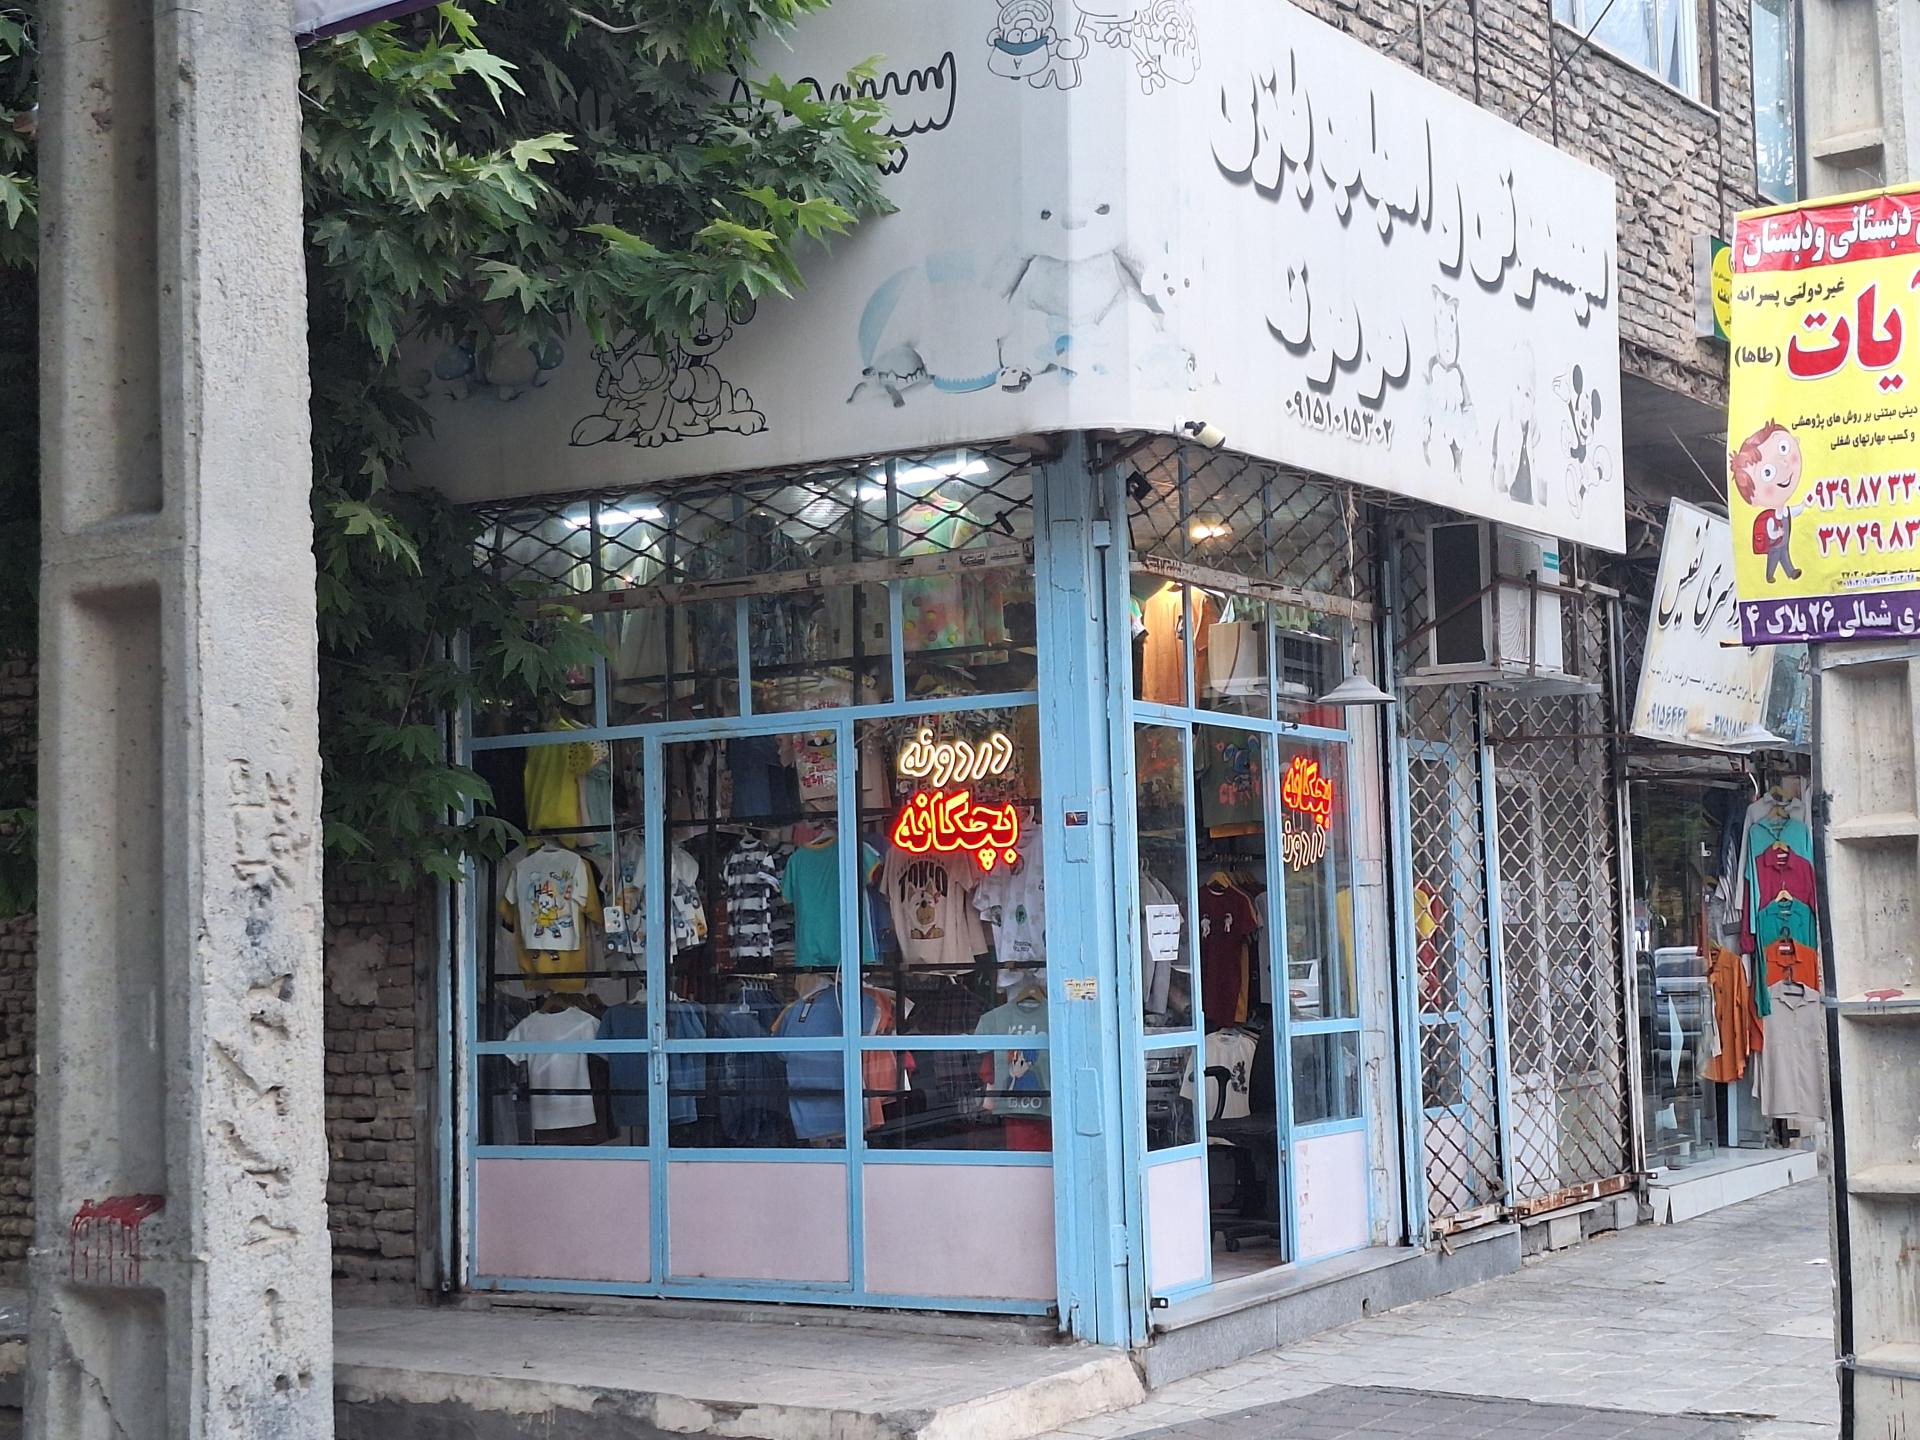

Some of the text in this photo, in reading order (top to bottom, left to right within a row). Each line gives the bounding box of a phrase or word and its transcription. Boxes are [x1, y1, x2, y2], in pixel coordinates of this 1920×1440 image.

[1209, 46, 1315, 214] بازی
[1318, 86, 1433, 247] اسباب
[1742, 216, 1813, 267] دبستان
[1829, 204, 1912, 259] دبستانی
[1736, 284, 1780, 307] پسرانه
[1264, 257, 1412, 412] دردونه
[1788, 270, 1920, 390] یات
[1734, 345, 1781, 368] (طاها)
[1285, 389, 1394, 447] ۰۹۱۵۱۰۱۵۳۰۲
[1791, 413, 1825, 430] پژوهشی
[1826, 412, 1841, 427] های
[1842, 409, 1862, 425] روش
[1863, 412, 1872, 423] بر
[1873, 408, 1897, 421] مبتنی
[1830, 433, 1851, 451] شغلی
[1852, 431, 1886, 448] مهارتهای
[1887, 428, 1909, 444] کسب
[1745, 604, 1760, 638] ۴
[1766, 603, 1808, 641] پلاک
[1808, 600, 1835, 633] ۲۶
[1837, 599, 1892, 638] شمالی
[900, 728, 1014, 788] دردونه
[1283, 756, 1332, 829] بچگانه
[894, 790, 1019, 872] بچگانه
